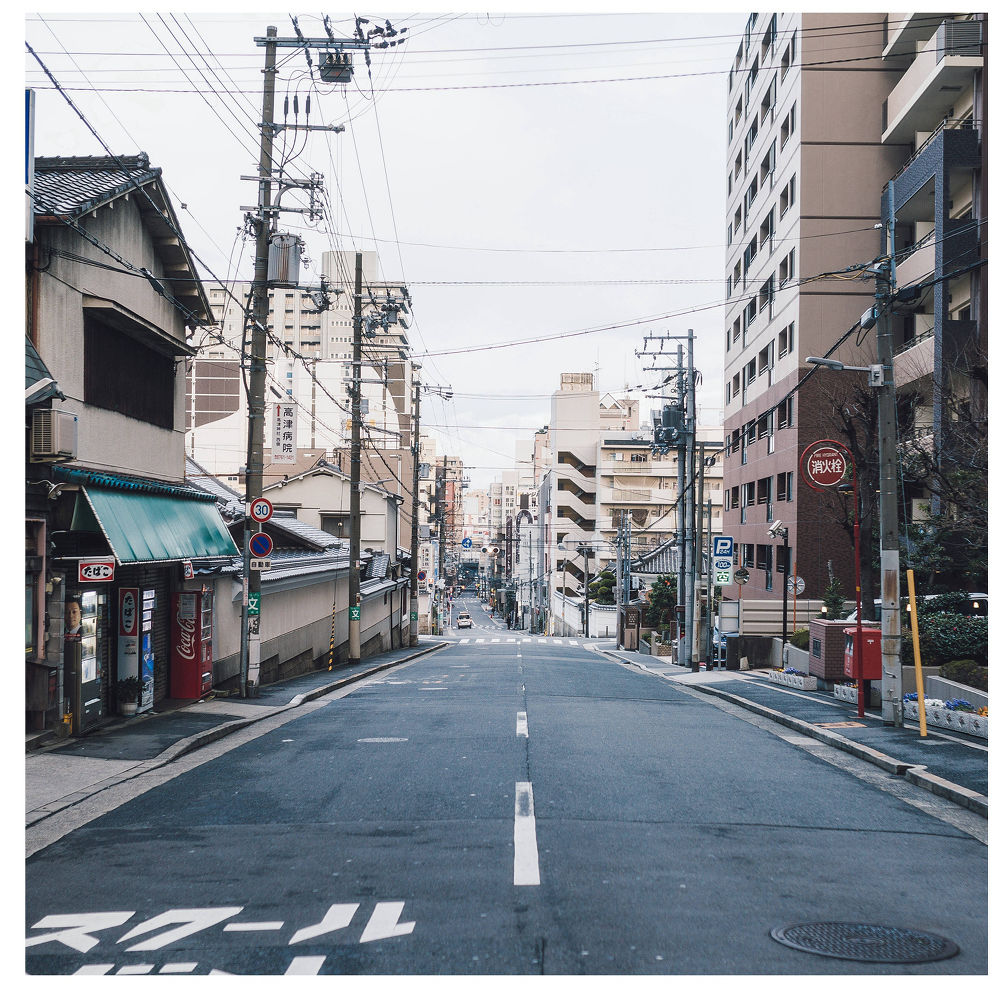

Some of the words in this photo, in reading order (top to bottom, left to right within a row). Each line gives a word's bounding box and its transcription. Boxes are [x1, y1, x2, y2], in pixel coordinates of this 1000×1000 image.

[282, 407, 293, 453] 高津病院
[812, 459, 842, 474] 消火栓
[255, 505, 268, 515] 30
[716, 540, 731, 554] P
[83, 566, 109, 577] たばこ
[716, 571, 729, 584] 空
[248, 598, 258, 610] 文
[124, 596, 134, 629] たばこ
[25, 901, 416, 953] スクール
